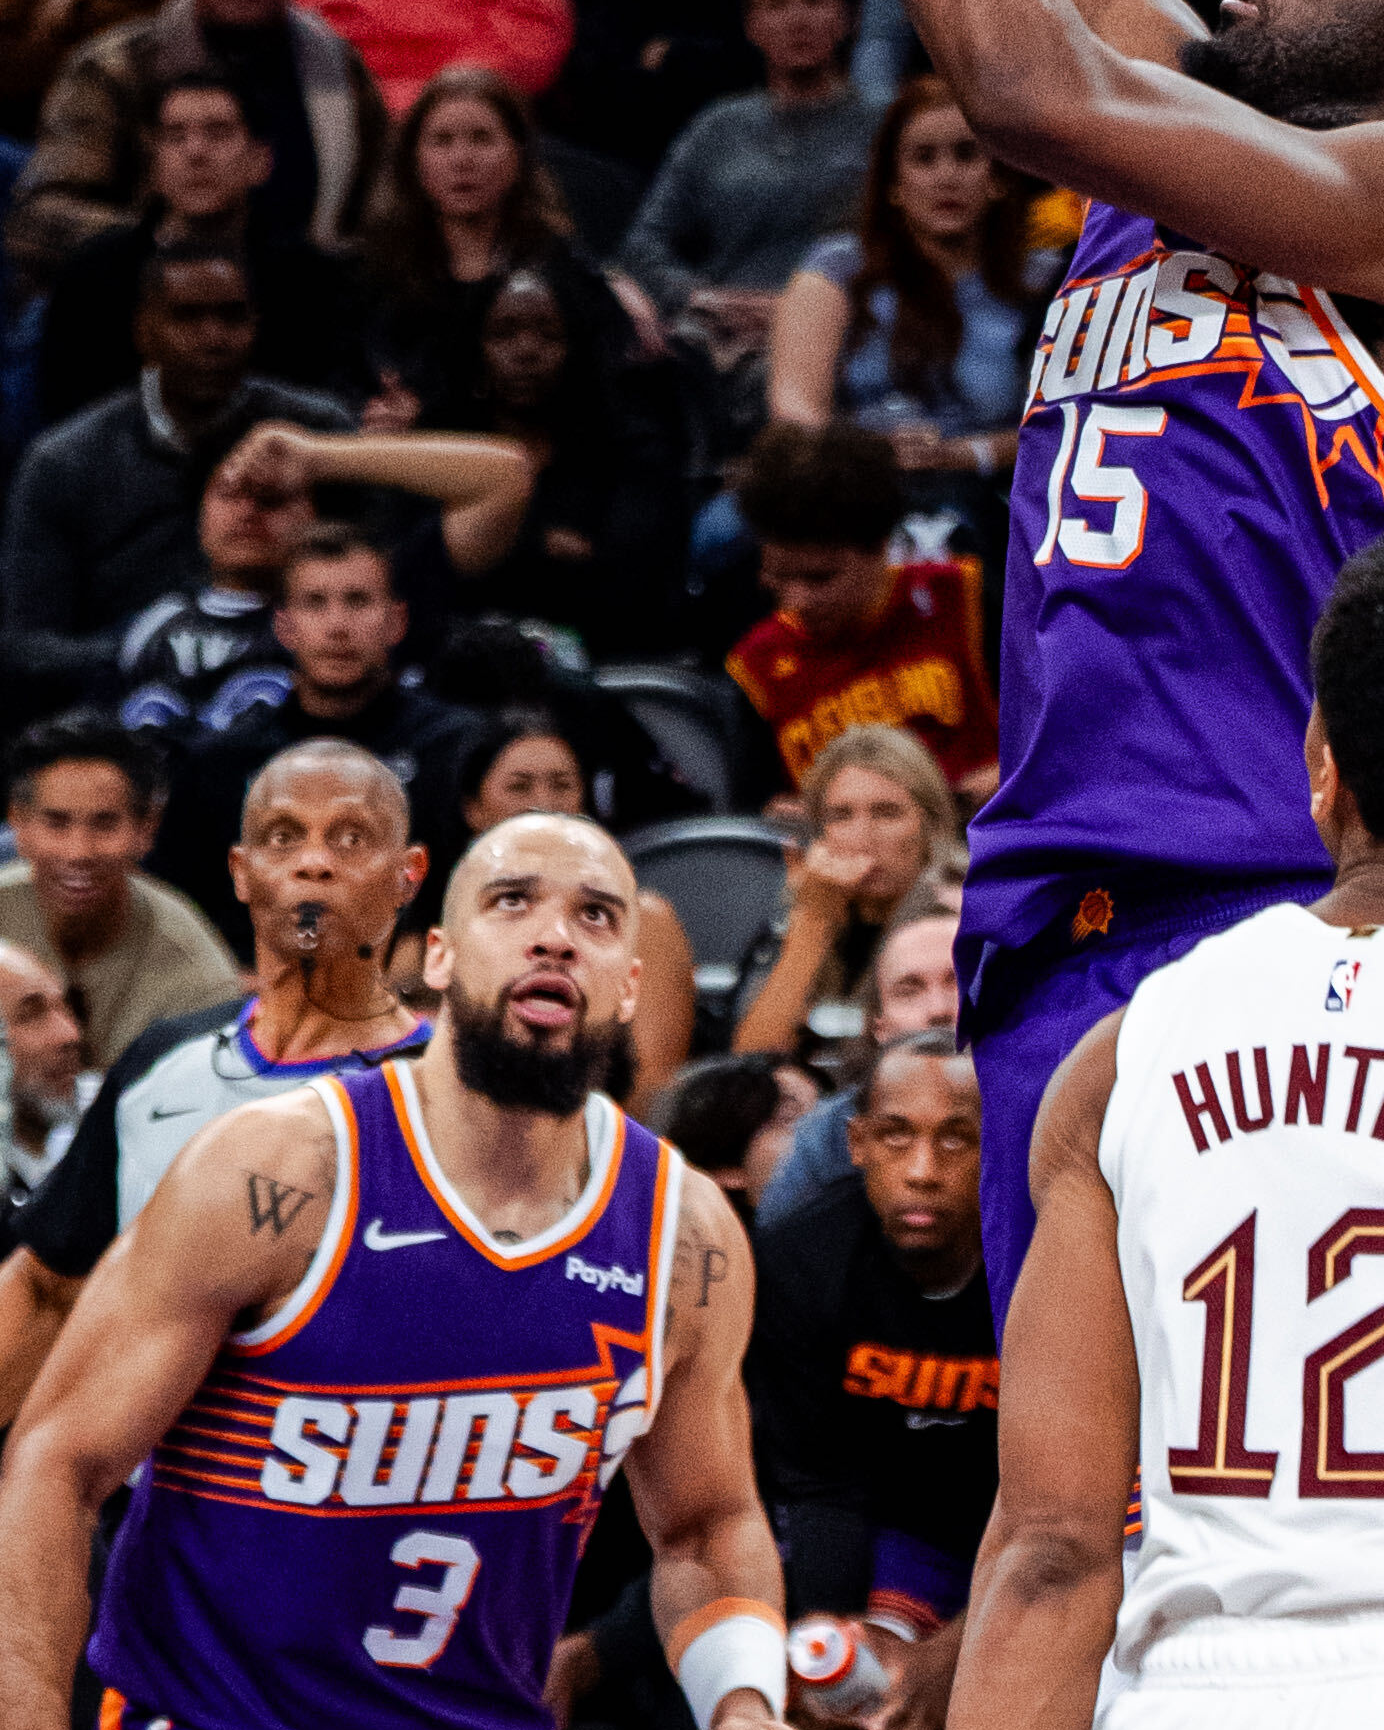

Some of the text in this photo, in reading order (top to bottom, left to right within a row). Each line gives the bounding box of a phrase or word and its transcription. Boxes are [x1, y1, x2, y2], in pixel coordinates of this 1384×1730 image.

[1033, 401, 1168, 570] 15
[566, 1255, 644, 1297] PayPal
[260, 1388, 598, 1507] SUNS
[362, 1529, 482, 1670] 3
